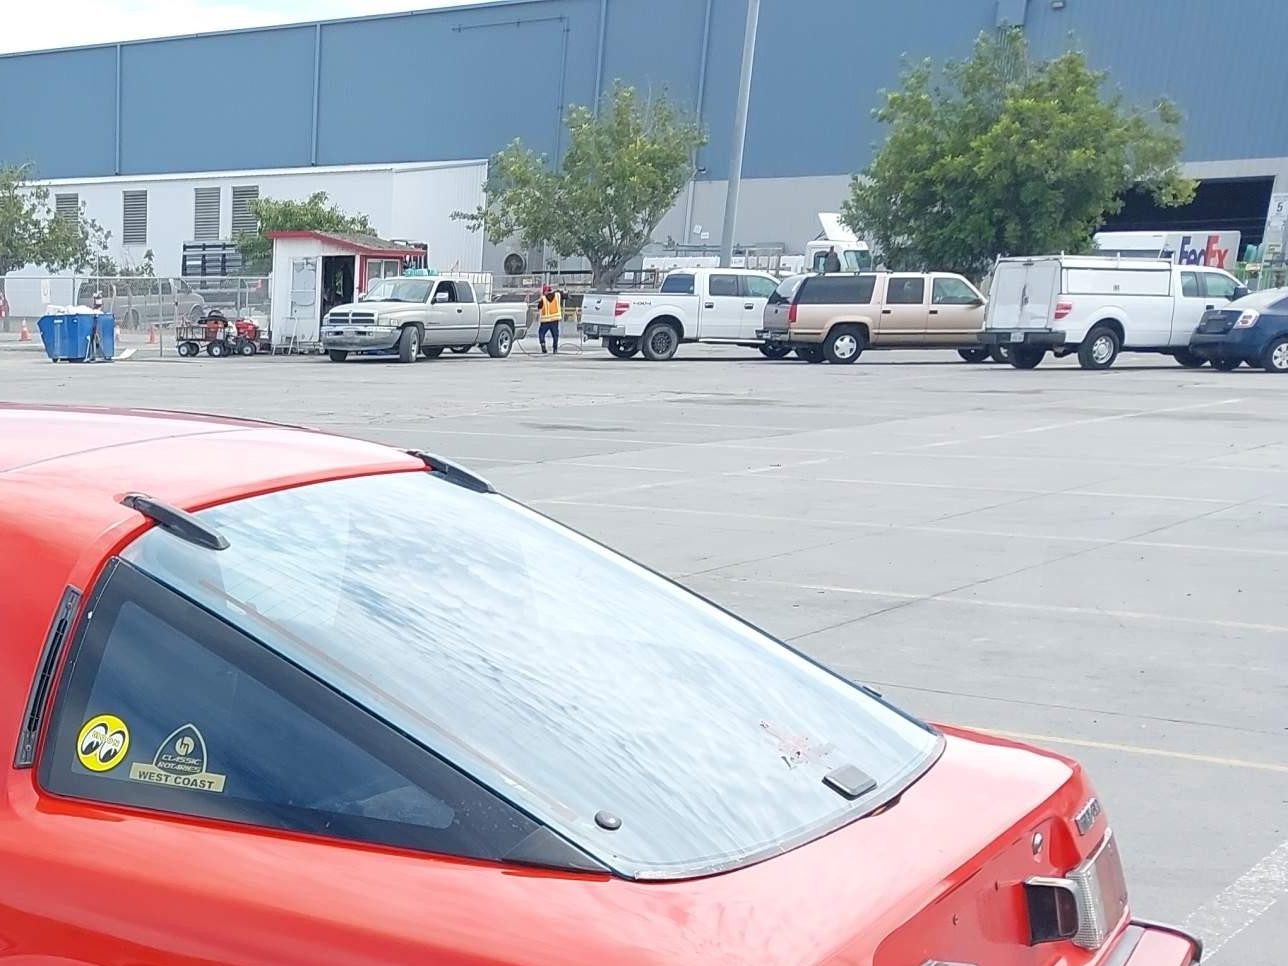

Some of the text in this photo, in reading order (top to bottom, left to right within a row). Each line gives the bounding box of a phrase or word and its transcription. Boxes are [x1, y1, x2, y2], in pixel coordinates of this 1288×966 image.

[1276, 202, 1283, 213] 5
[162, 754, 202, 766] CLASSIC
[157, 761, 202, 773] ROTARIES
[138, 770, 215, 790] WEST COAST
